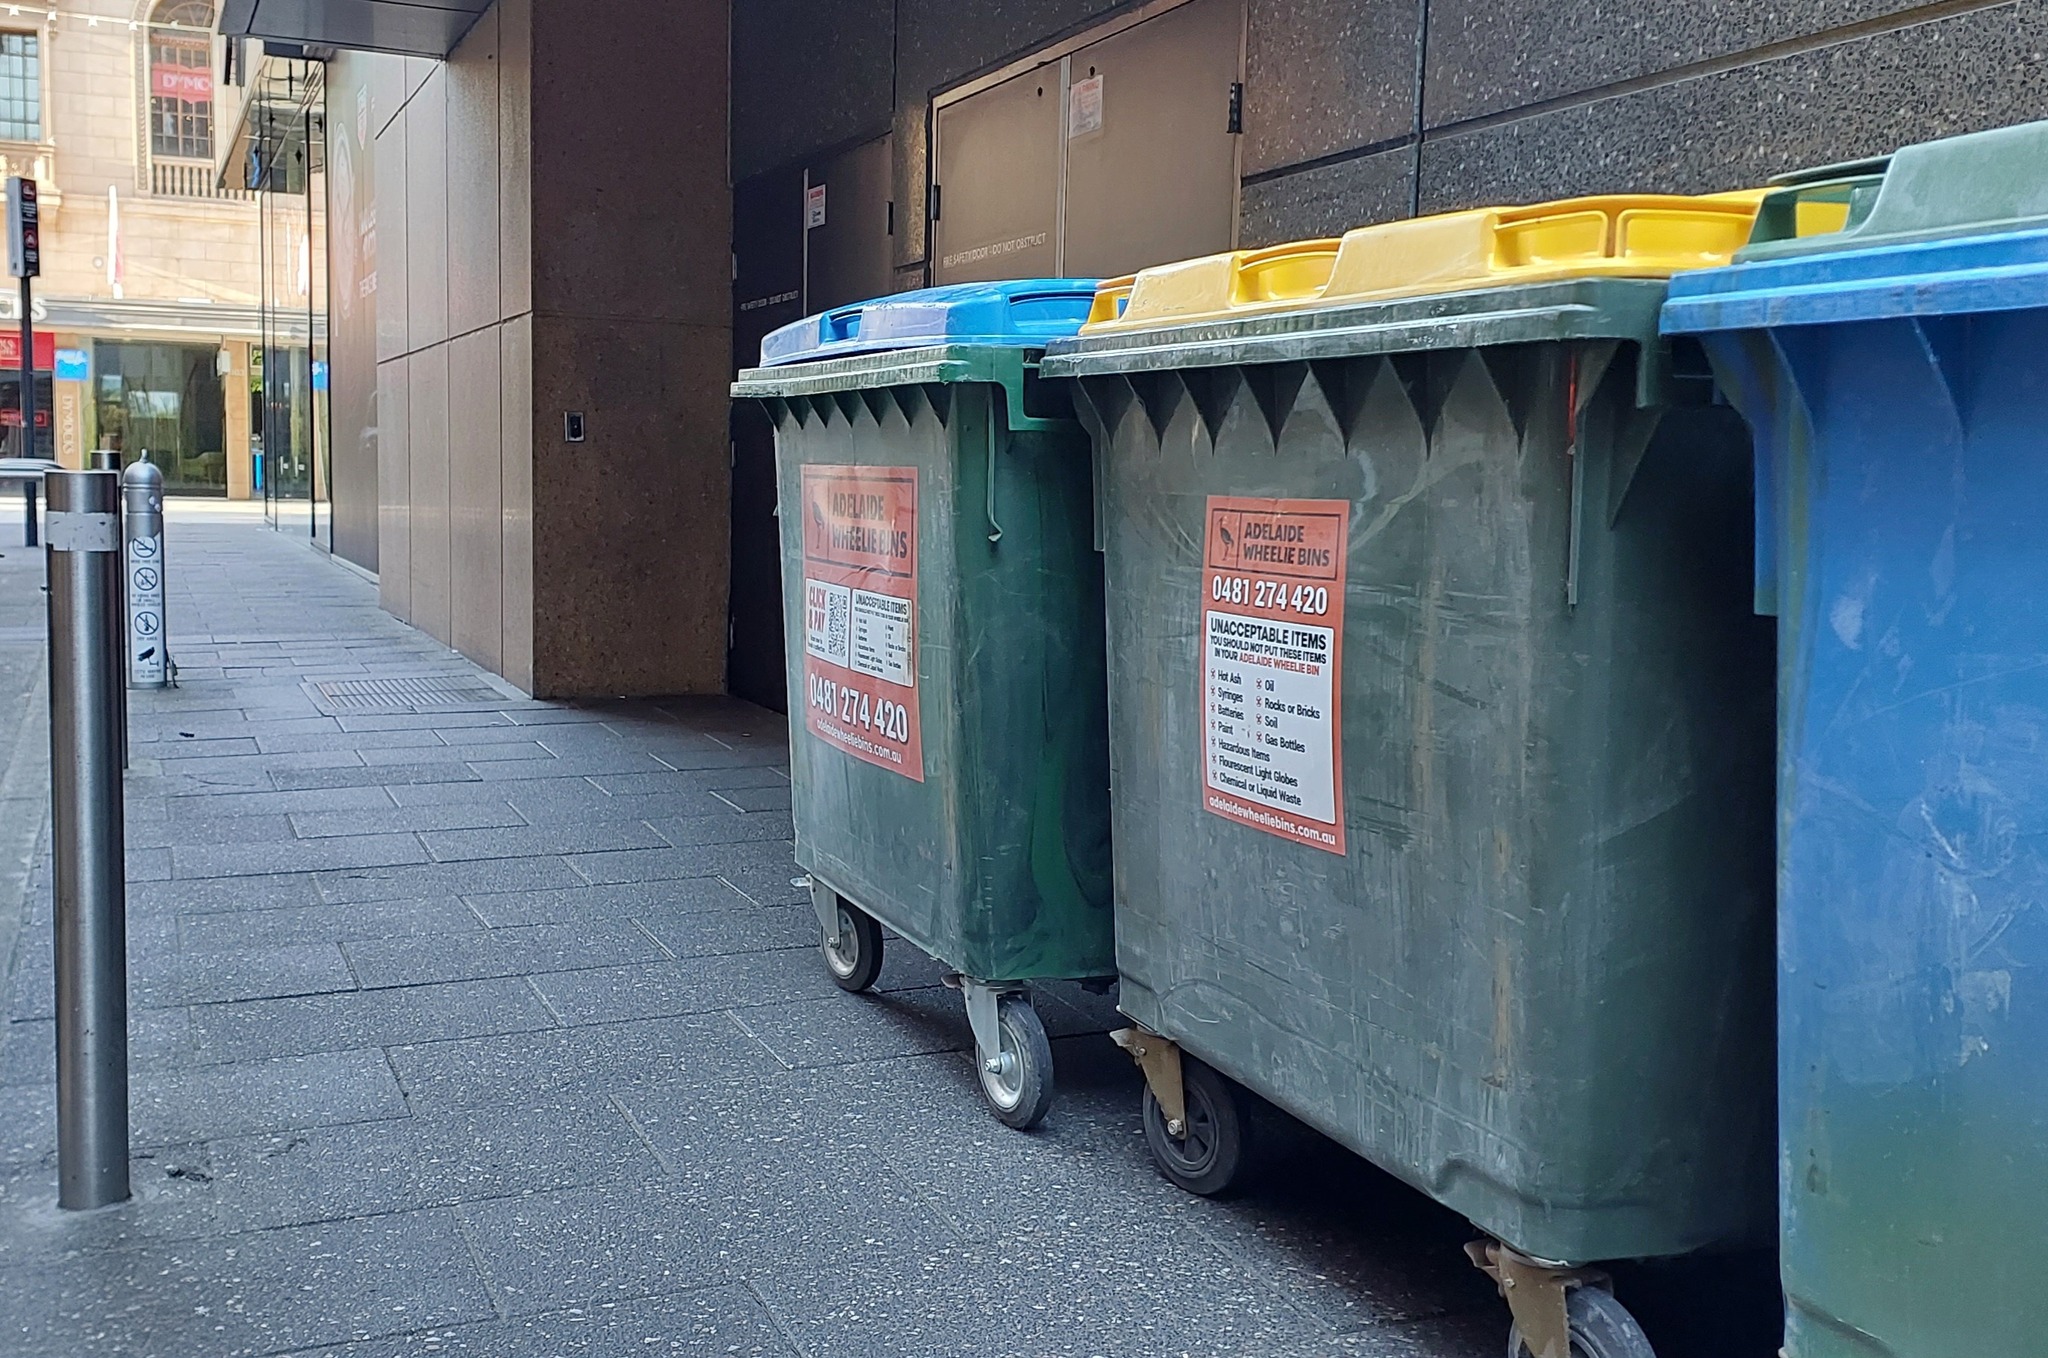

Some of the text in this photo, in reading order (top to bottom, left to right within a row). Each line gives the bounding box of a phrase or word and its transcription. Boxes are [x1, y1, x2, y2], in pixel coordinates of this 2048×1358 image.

[992, 244, 1001, 255] DO
[1002, 240, 1015, 253] NOT
[832, 492, 884, 521] ADELAIDE
[832, 523, 908, 559] WHEELIE BINS
[1244, 522, 1304, 543] ADELAIDE
[1243, 543, 1330, 567] WHEELIE BINS
[1212, 575, 1328, 615] 0481 274 420
[890, 601, 908, 616] ITEMS
[1210, 617, 1327, 650] UNACCEPTABLE ITEMS
[1210, 635, 1327, 664] YOU SHOULD NOT PUT THESE ITEMS
[1214, 647, 1320, 676] IN YOUR ADELAIDE WHEELIE BIN
[1217, 669, 1242, 685] Hot Ash
[1265, 679, 1275, 691] Oil
[1217, 686, 1243, 704] Syringes
[810, 672, 909, 743] 0481 274 420
[1217, 704, 1244, 720] Batteries
[1265, 697, 1320, 719] Rocks or Bricks
[1217, 721, 1233, 735] Paint
[1265, 715, 1278, 728] Soil
[816, 718, 903, 765] adelaidewheeliebins.com.au
[1218, 737, 1270, 762] Hazardous Items
[1265, 733, 1305, 753] Gas Bottles
[1255, 765, 1272, 781] Light
[1273, 771, 1298, 787] Globes
[1219, 772, 1302, 806] Chemical or Liquid Waste
[1209, 796, 1336, 845] adelaidewheeliebins.com.au
